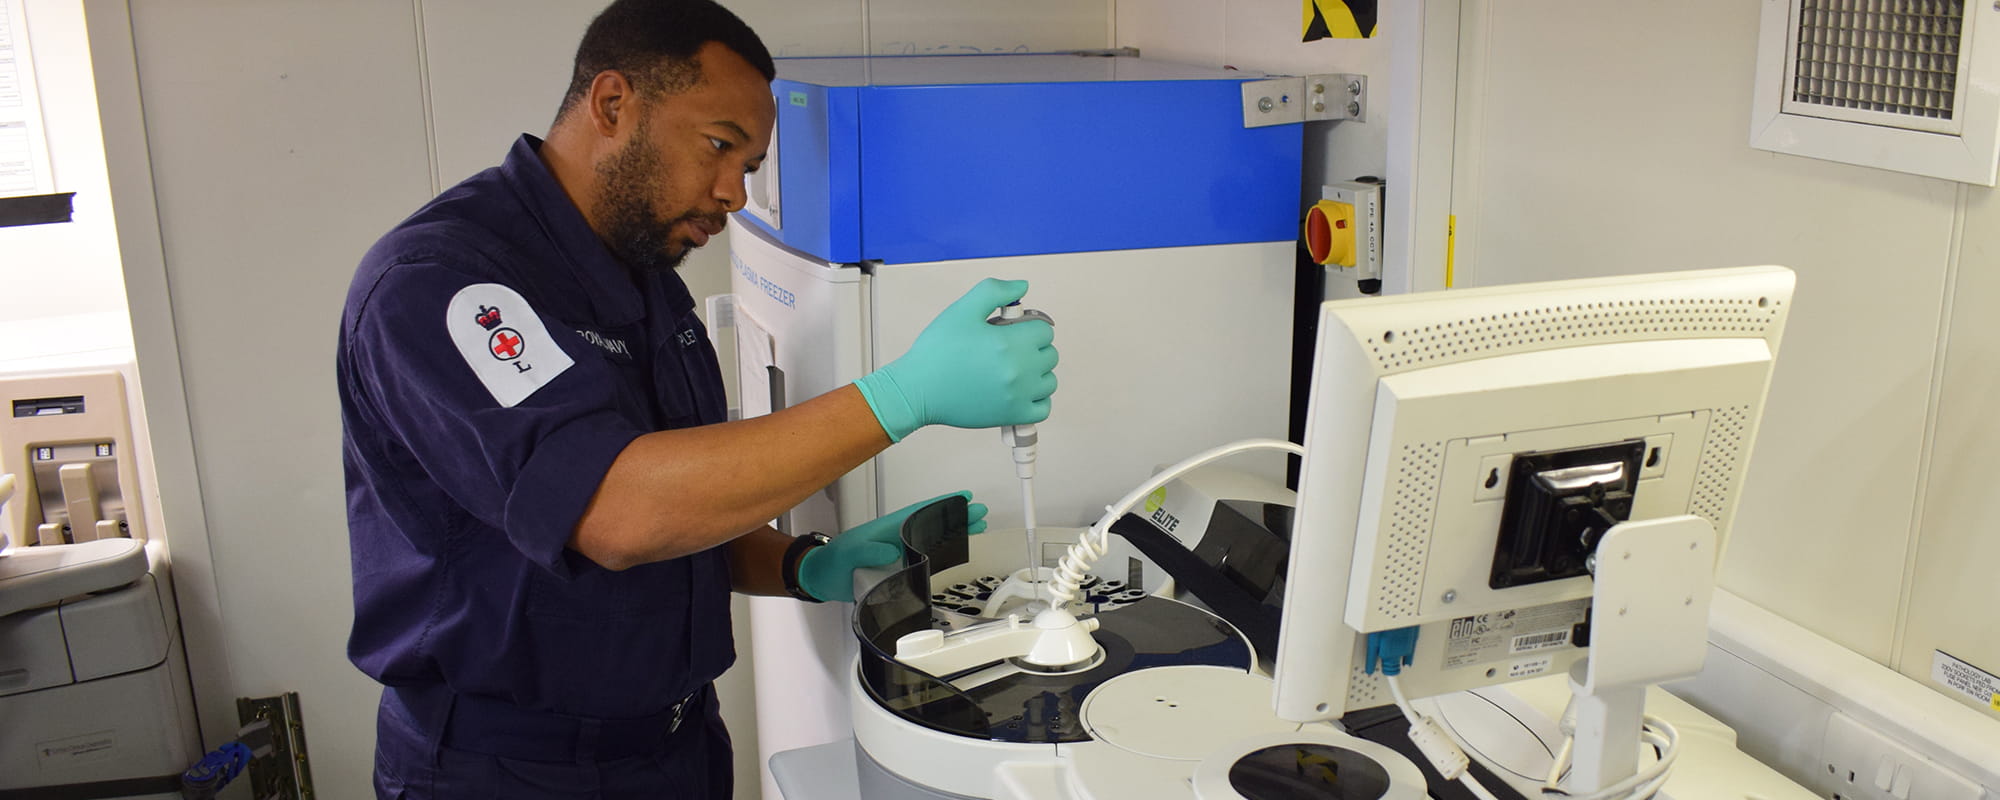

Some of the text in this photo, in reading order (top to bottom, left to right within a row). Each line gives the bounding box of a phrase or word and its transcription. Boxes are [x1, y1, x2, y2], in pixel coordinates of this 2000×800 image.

[760, 276, 796, 310] FREEZER
[1151, 507, 1180, 532] ELITE
[1952, 662, 1981, 679] PATHOLOGY
[1953, 669, 1976, 684] SOCKETS
